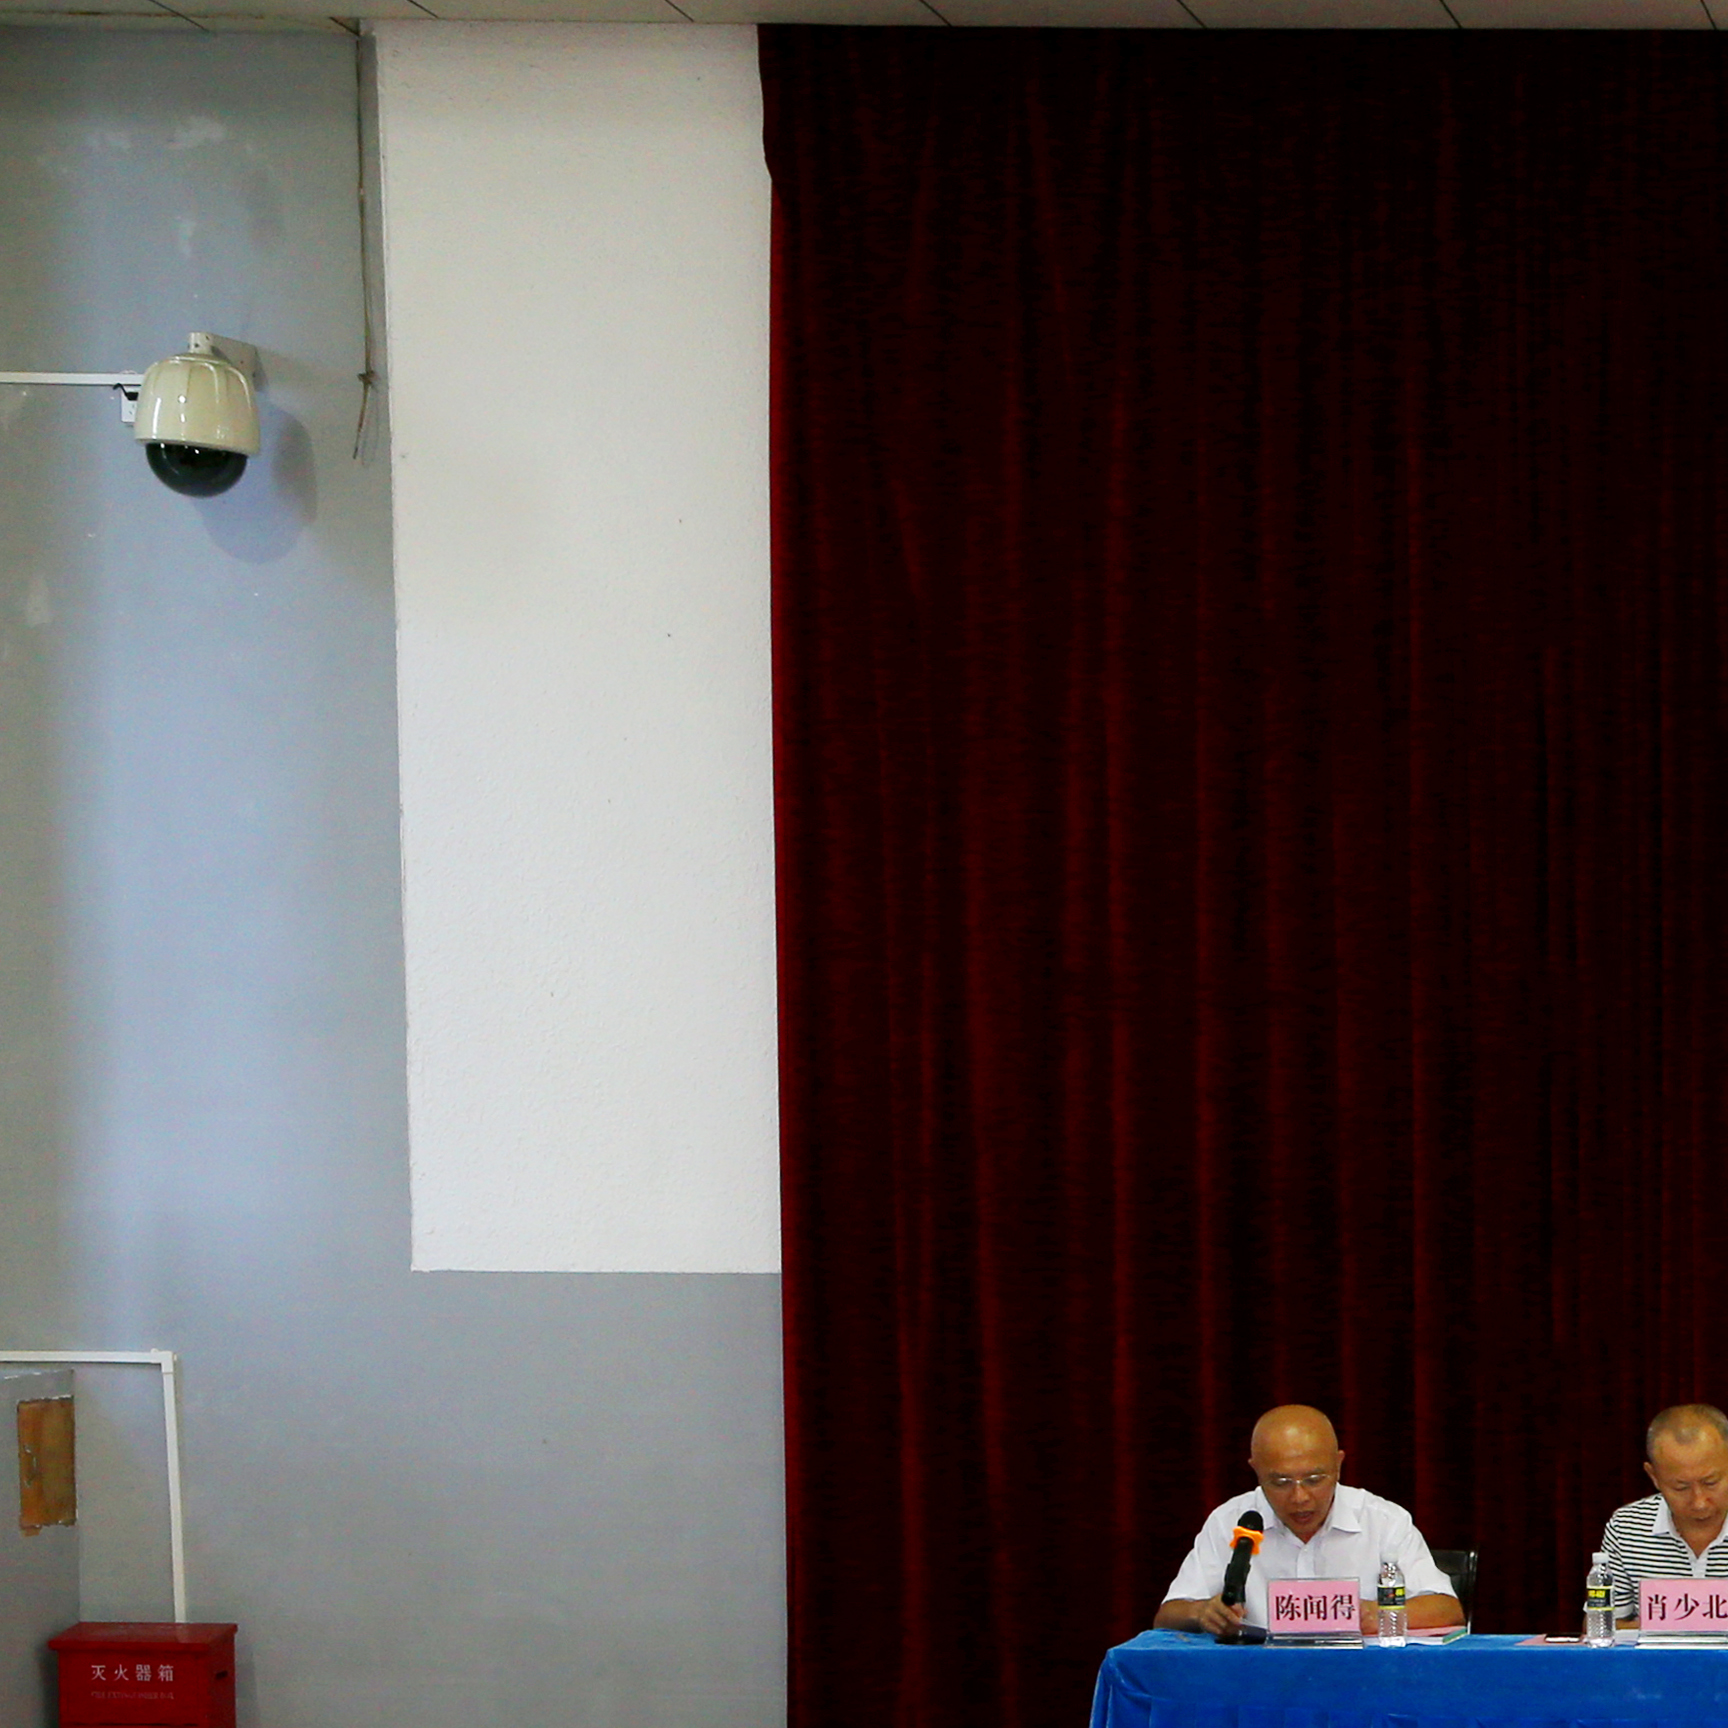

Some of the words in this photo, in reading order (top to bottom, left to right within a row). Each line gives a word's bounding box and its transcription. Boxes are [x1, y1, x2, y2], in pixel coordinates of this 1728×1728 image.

[1275, 1594, 1356, 1622] 陈闻得
[1646, 1594, 1728, 1621] 肖少北
[90, 1664, 175, 1682] 灭火器箱
